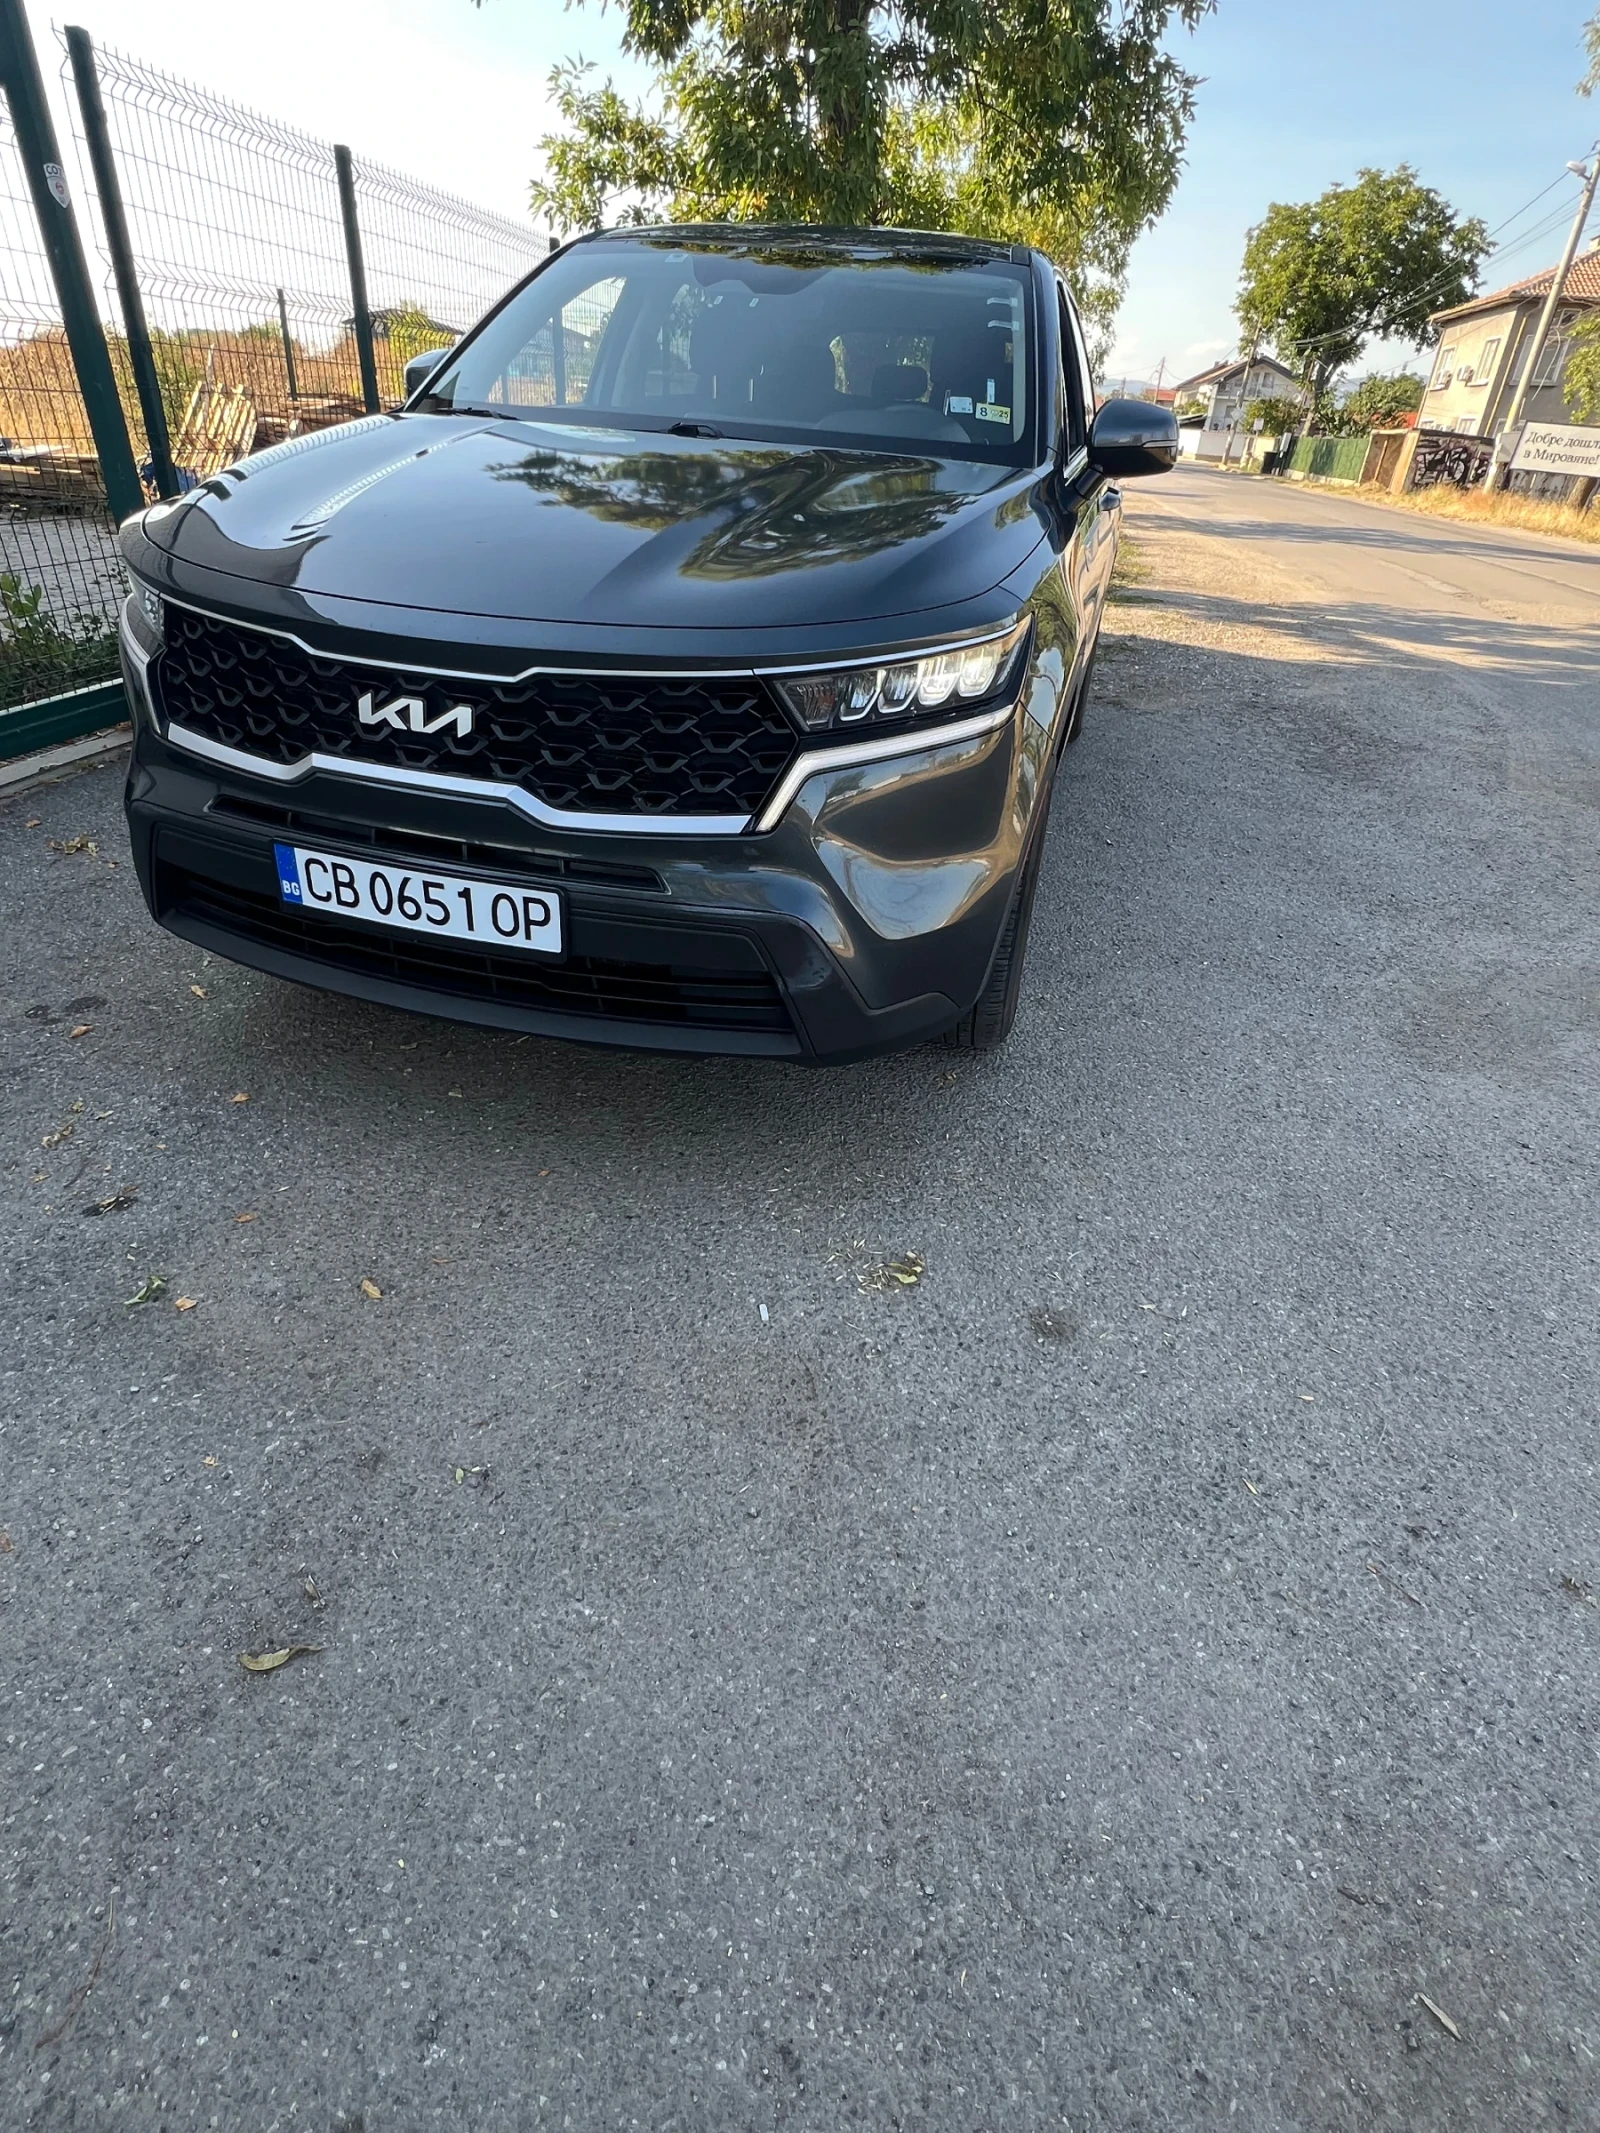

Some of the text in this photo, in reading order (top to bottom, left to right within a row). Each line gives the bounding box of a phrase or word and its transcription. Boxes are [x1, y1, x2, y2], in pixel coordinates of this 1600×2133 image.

[980, 406, 988, 417] 8
[1525, 431, 1600, 449] Добре дошл
[1523, 448, 1600, 465] в Мировяне!
[358, 691, 473, 739] KIA
[282, 880, 300, 896] BG
